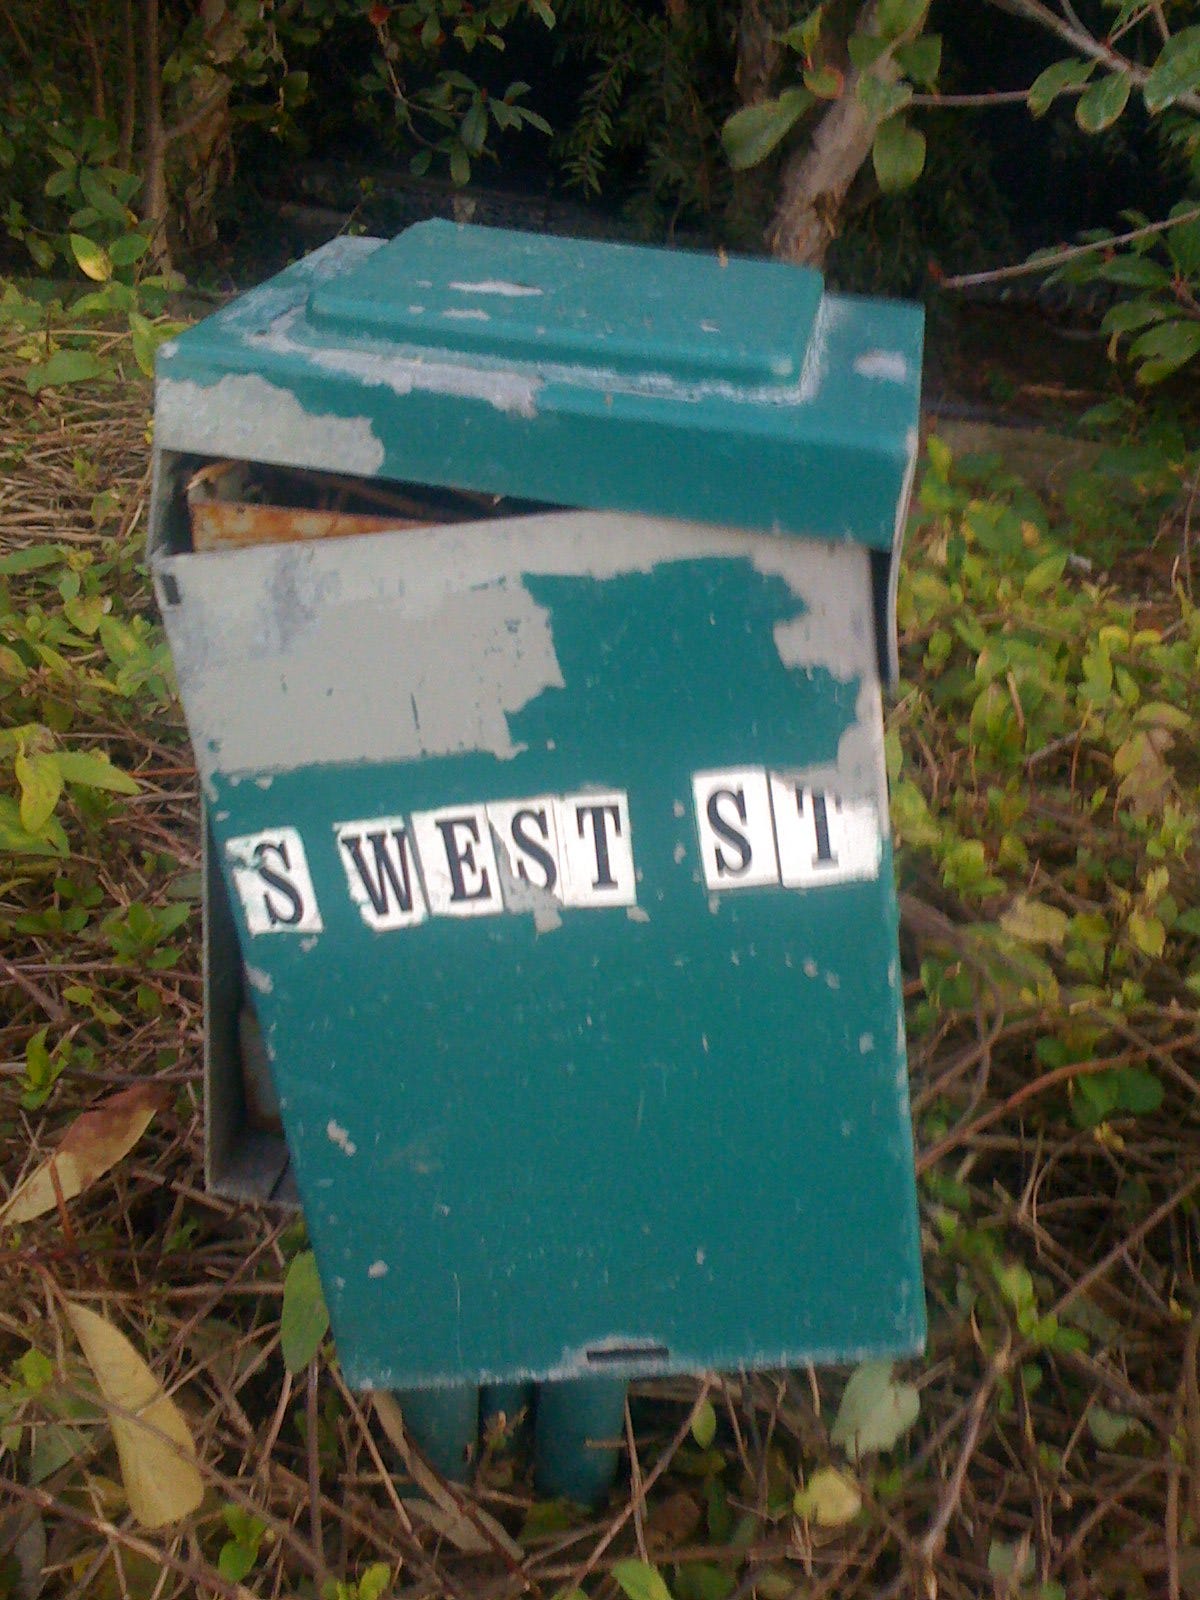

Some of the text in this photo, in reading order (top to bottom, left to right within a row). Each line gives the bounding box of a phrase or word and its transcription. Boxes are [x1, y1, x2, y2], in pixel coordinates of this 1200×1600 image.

[253, 784, 841, 926] S WEST ST
